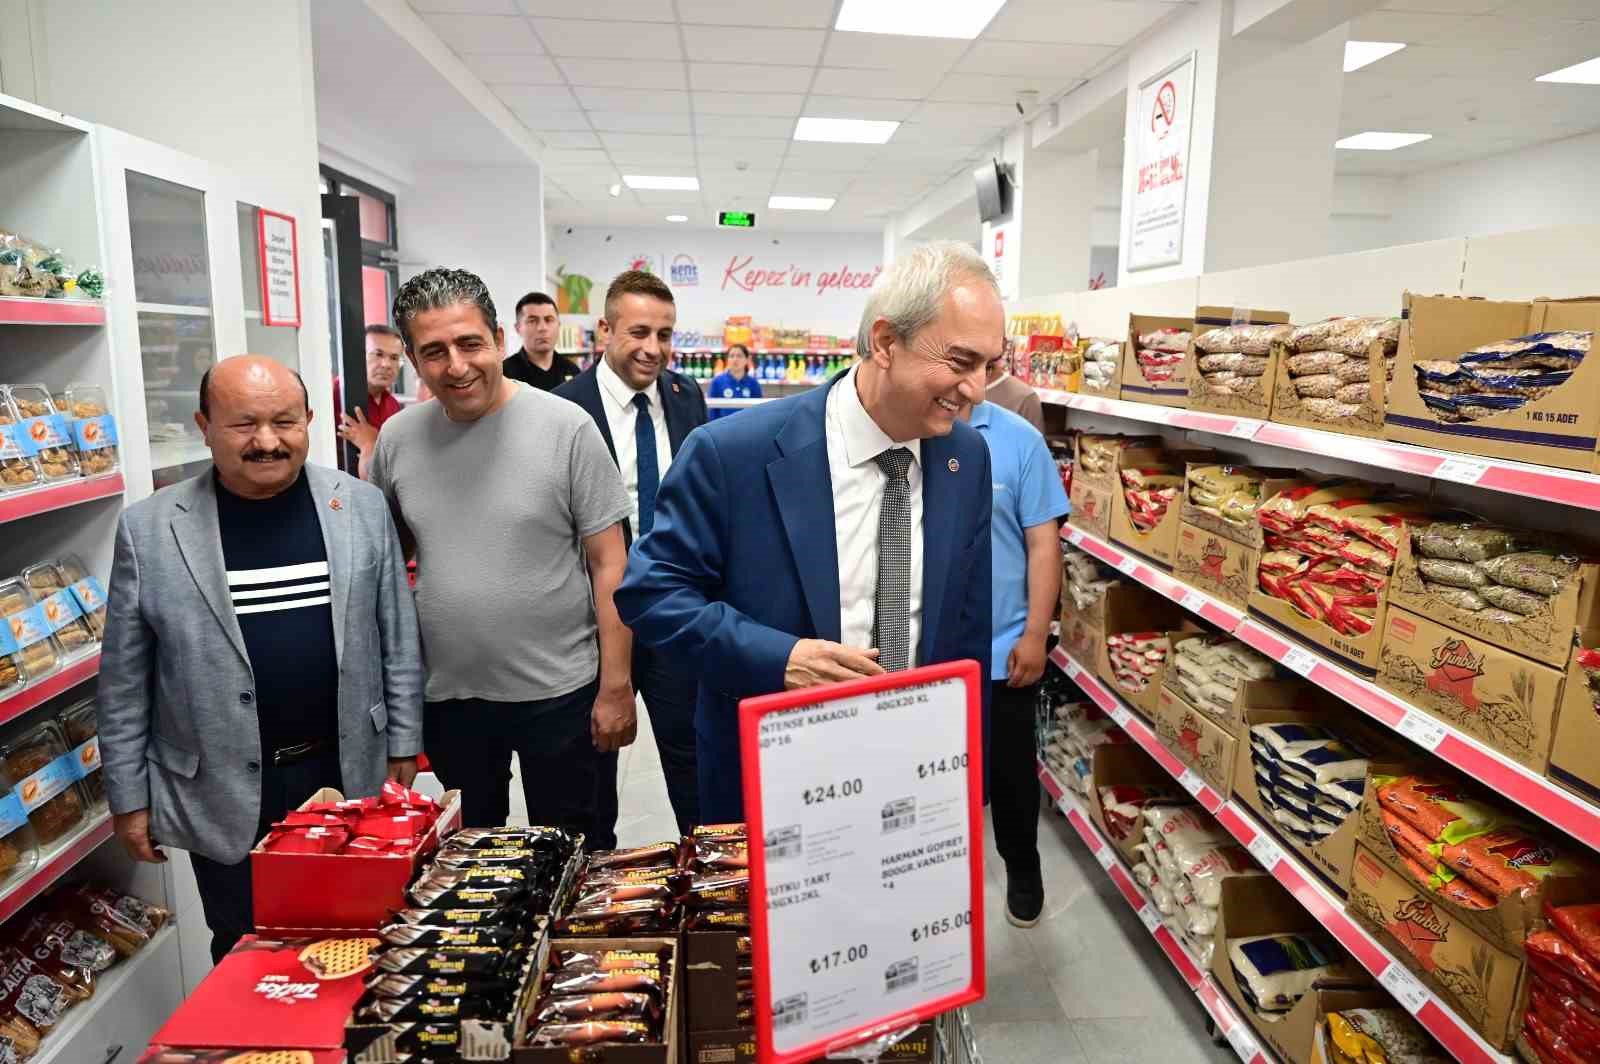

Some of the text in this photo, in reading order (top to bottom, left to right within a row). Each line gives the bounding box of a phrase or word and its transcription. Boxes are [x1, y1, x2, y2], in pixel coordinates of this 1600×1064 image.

[721, 255, 811, 293] Kepez'in
[1532, 411, 1543, 421] KG
[1545, 413, 1555, 422] 15
[1556, 413, 1578, 424] ADET
[761, 707, 858, 735] NTENSE KAKAOLU
[803, 778, 863, 805] ₺24.00
[882, 836, 963, 866] HARMAN GOFRET
[803, 872, 831, 887] TART
[911, 910, 972, 942] ₺165.00
[809, 943, 868, 974] ₺17.00
[891, 1040, 927, 1055] owni
